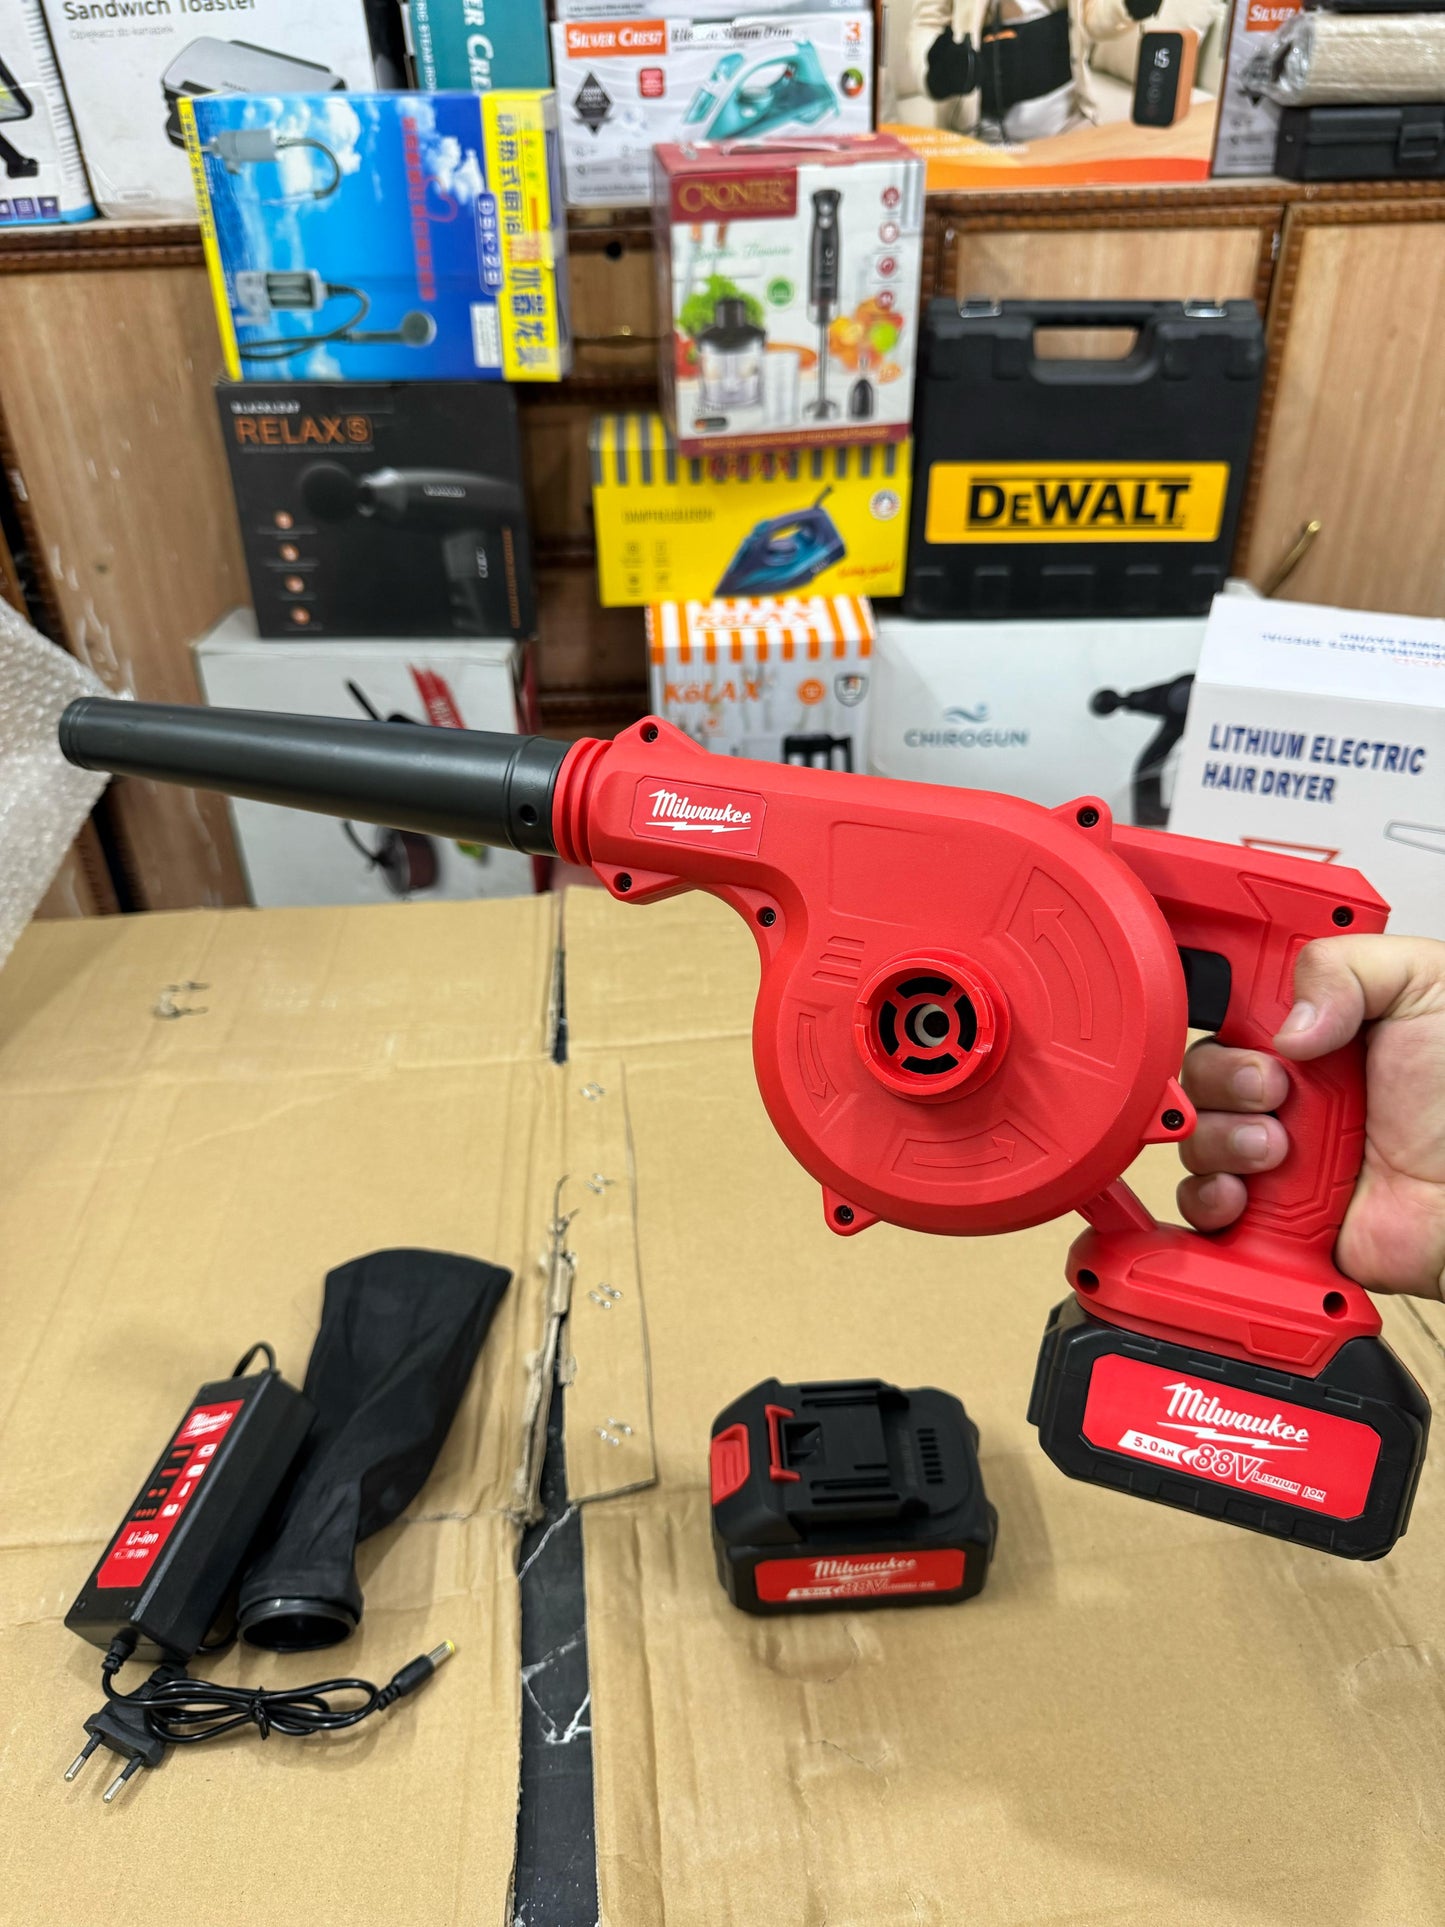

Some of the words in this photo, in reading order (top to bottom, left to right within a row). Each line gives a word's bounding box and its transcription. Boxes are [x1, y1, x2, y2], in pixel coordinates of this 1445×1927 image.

[63, 0, 170, 20] Sandwich
[568, 29, 616, 48] SILVER
[618, 27, 664, 47] CREST
[235, 415, 345, 444] RELAX
[903, 728, 1030, 748] CHIROGUN
[1208, 723, 1306, 759] LITHIUM
[1309, 735, 1427, 775] ELECTRIC
[1201, 762, 1256, 793] HAIR
[1259, 769, 1337, 803] DRYER
[649, 789, 751, 824] Milwaukee
[1162, 1381, 1309, 1443] Milwaukee
[1191, 1443, 1260, 1483] 88V
[1252, 1470, 1300, 1494] LITHIUM
[1302, 1485, 1327, 1503] ION
[808, 1557, 917, 1578] Milwaukee
